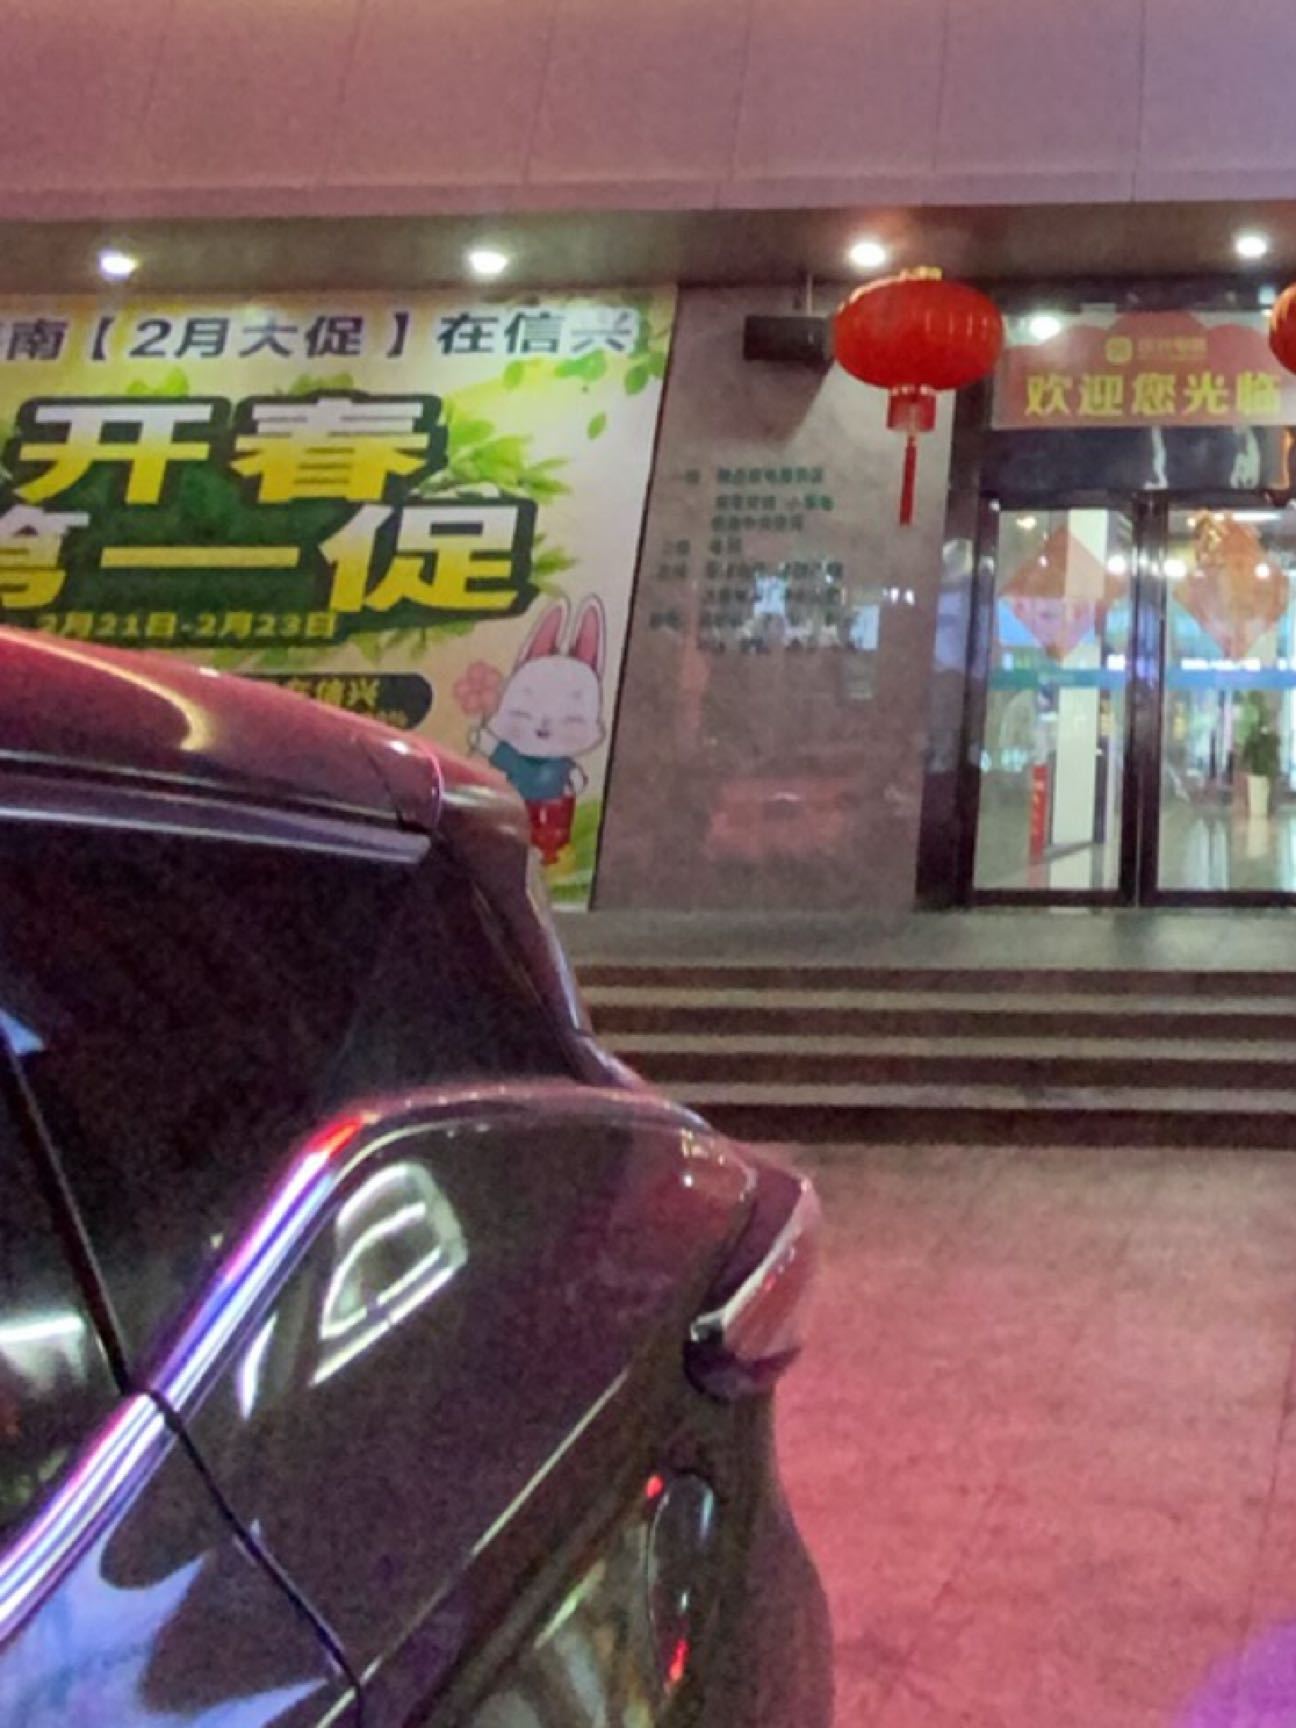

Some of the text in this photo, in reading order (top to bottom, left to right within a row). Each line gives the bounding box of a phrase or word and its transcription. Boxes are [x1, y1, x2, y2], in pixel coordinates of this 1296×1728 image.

[0, 311, 636, 361] 南【2月大促】在信兴
[1025, 371, 1281, 417] 欢迎您光临
[15, 397, 430, 505] 开春
